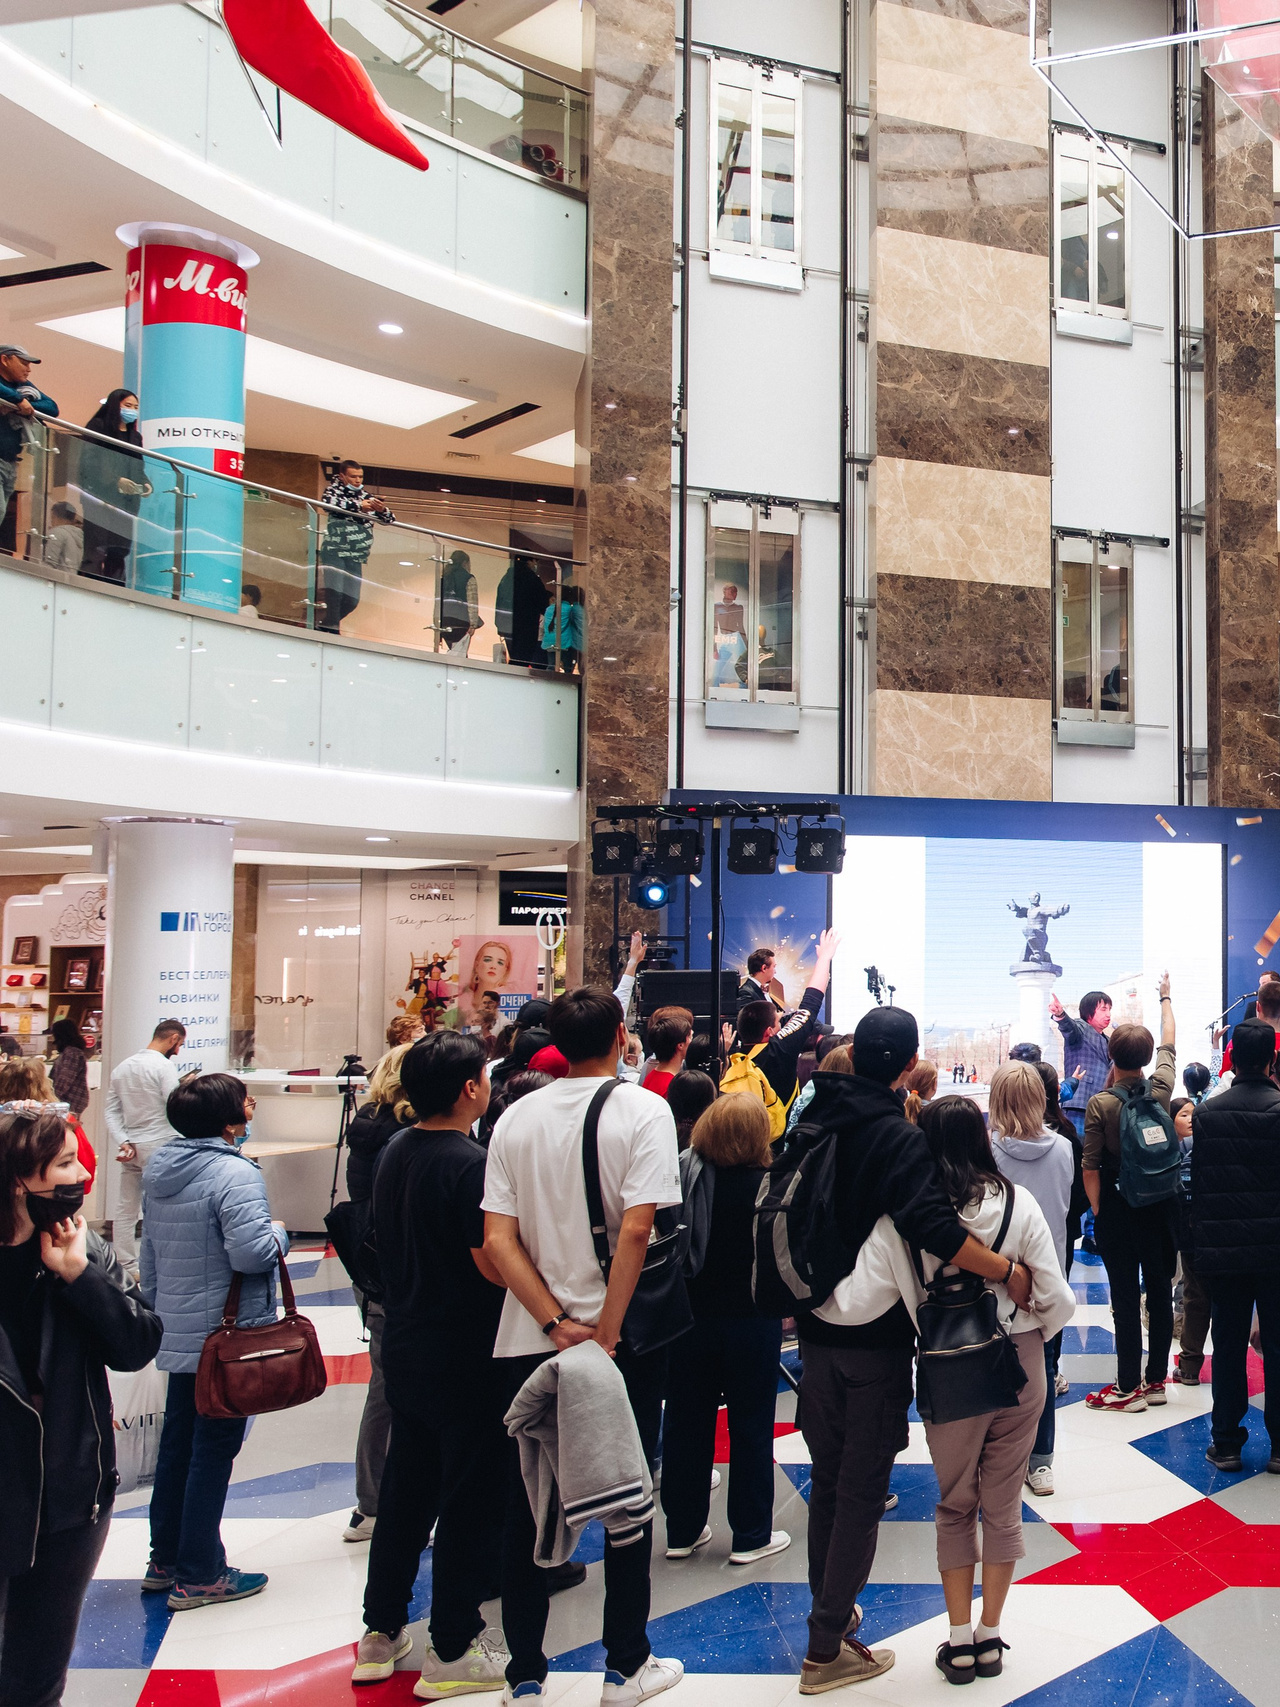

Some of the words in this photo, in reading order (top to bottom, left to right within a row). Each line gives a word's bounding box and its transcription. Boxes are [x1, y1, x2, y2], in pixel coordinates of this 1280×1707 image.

[157, 427, 186, 438] МЫ
[410, 882, 456, 890] CHANCE
[409, 893, 455, 901] CHANEL
[159, 993, 220, 1004] НОВИНКИ
